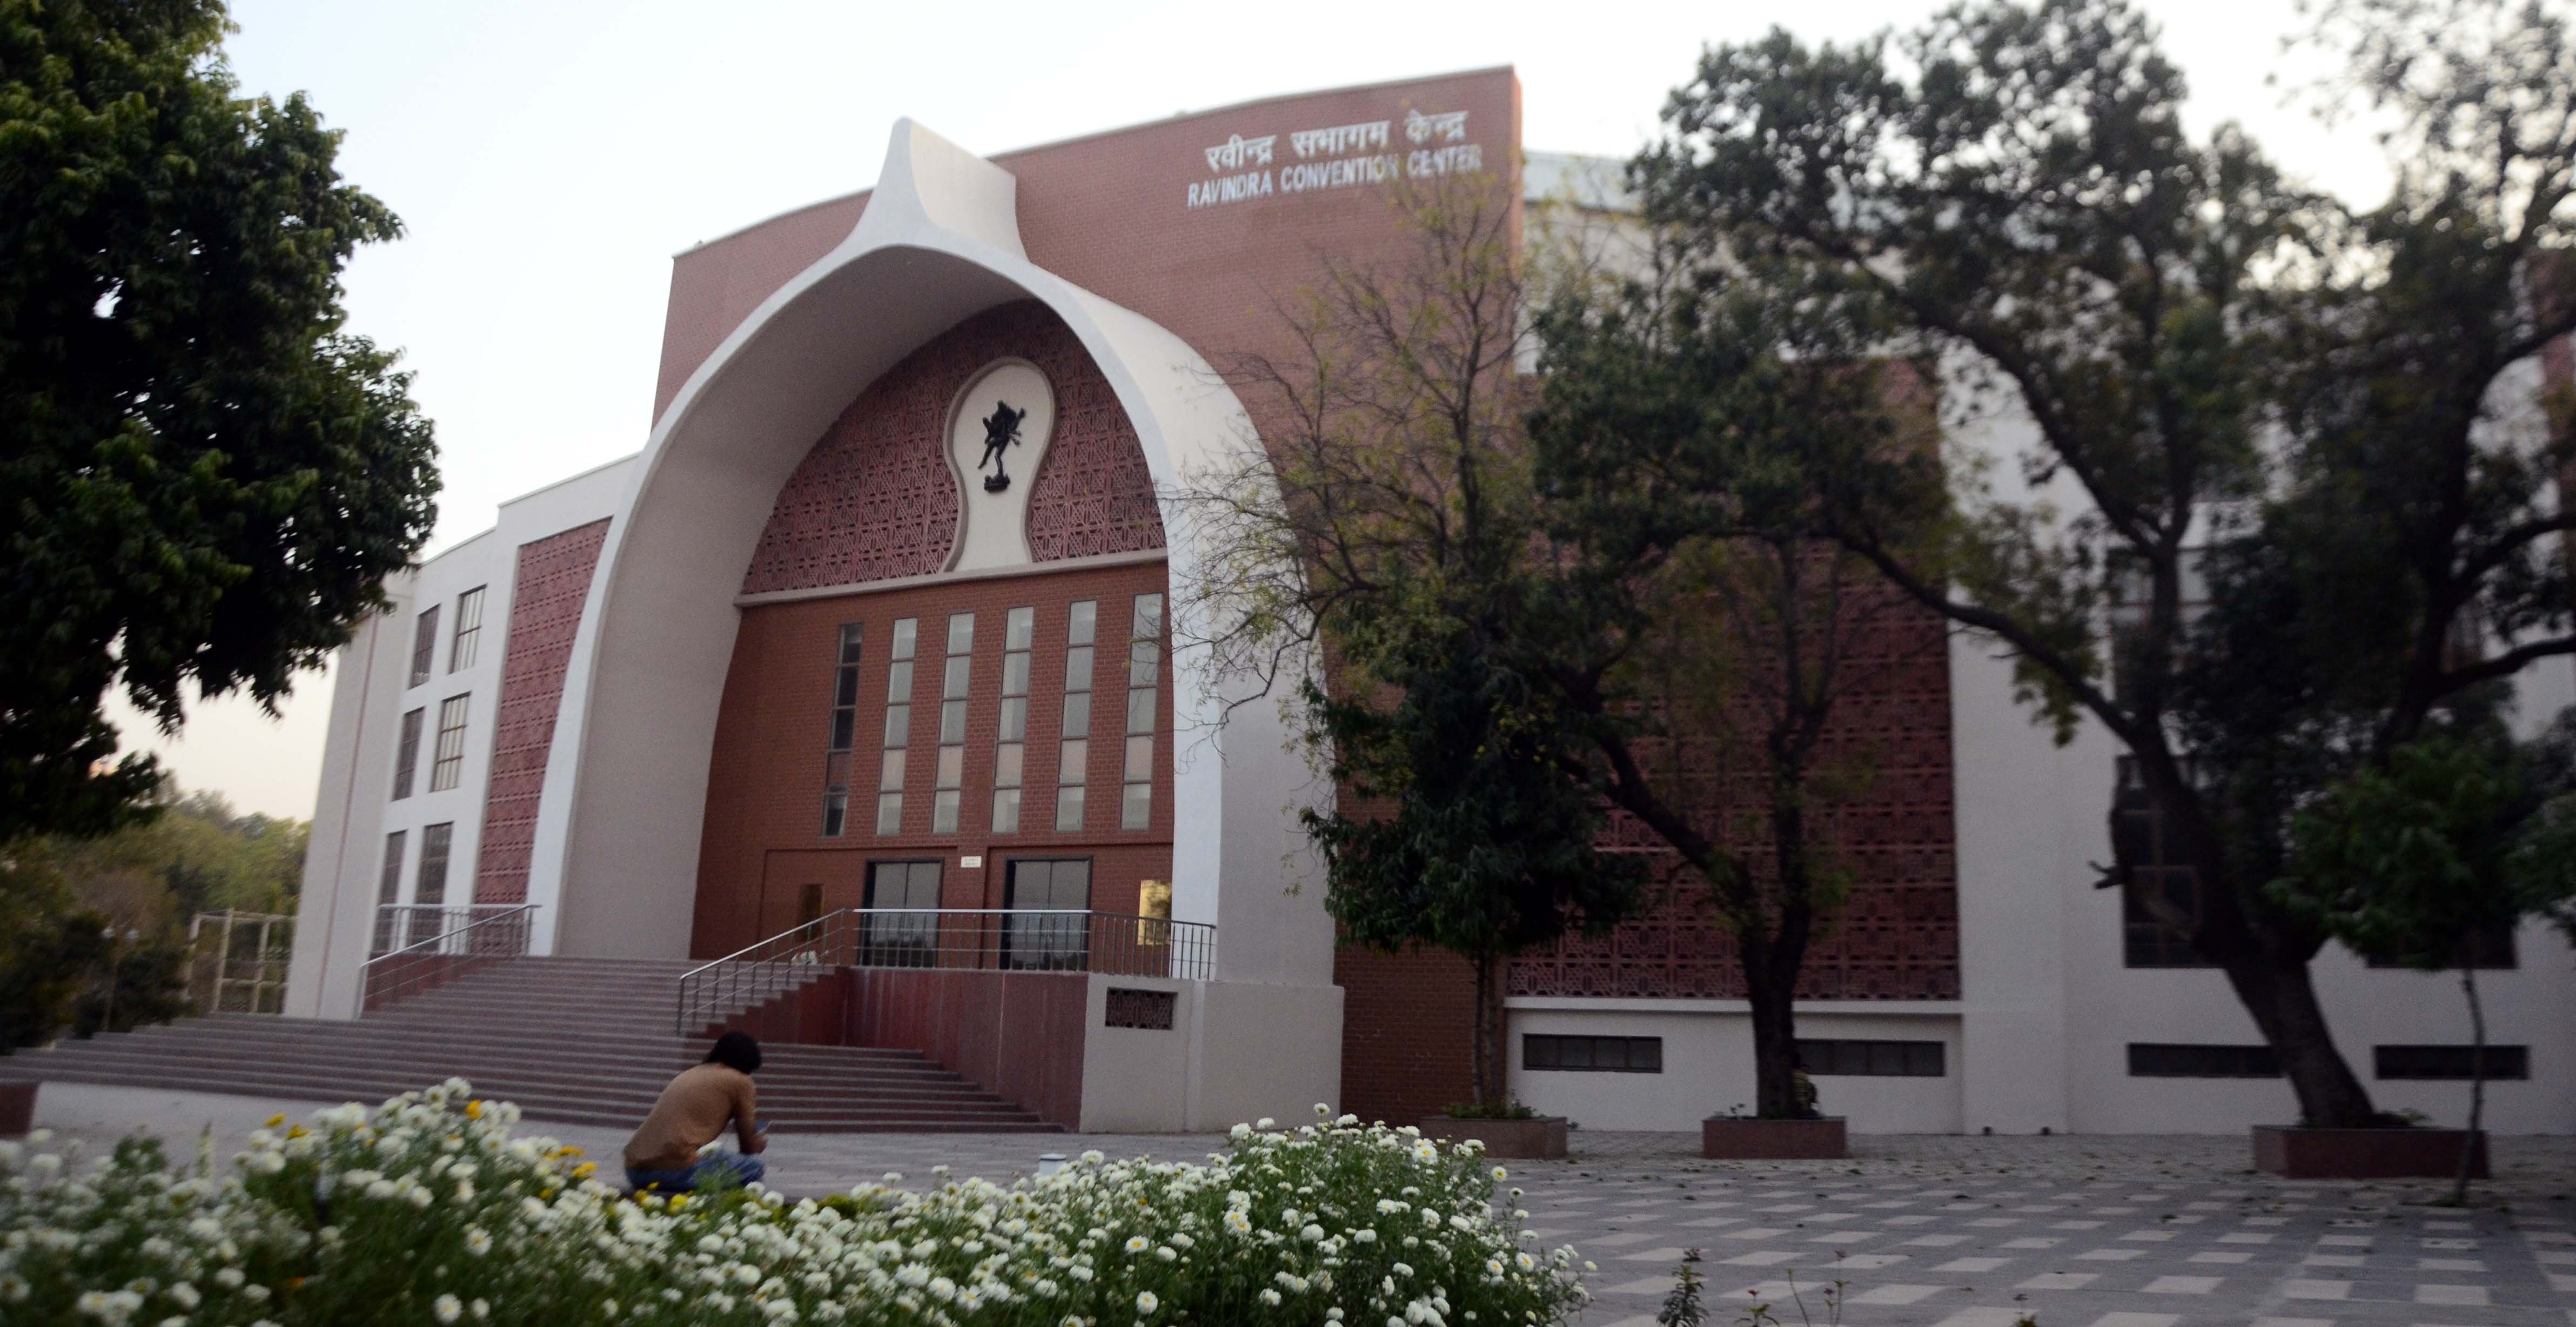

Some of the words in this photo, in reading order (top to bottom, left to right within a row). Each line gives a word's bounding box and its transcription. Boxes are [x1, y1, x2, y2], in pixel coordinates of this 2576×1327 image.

[1204, 133, 1277, 173] रवीन्द्र
[1404, 109, 1470, 145] केन्द्र
[1188, 170, 1273, 207] RAVINDRA
[1280, 154, 1400, 194] CONVENTION
[1407, 144, 1482, 179] CENTER
